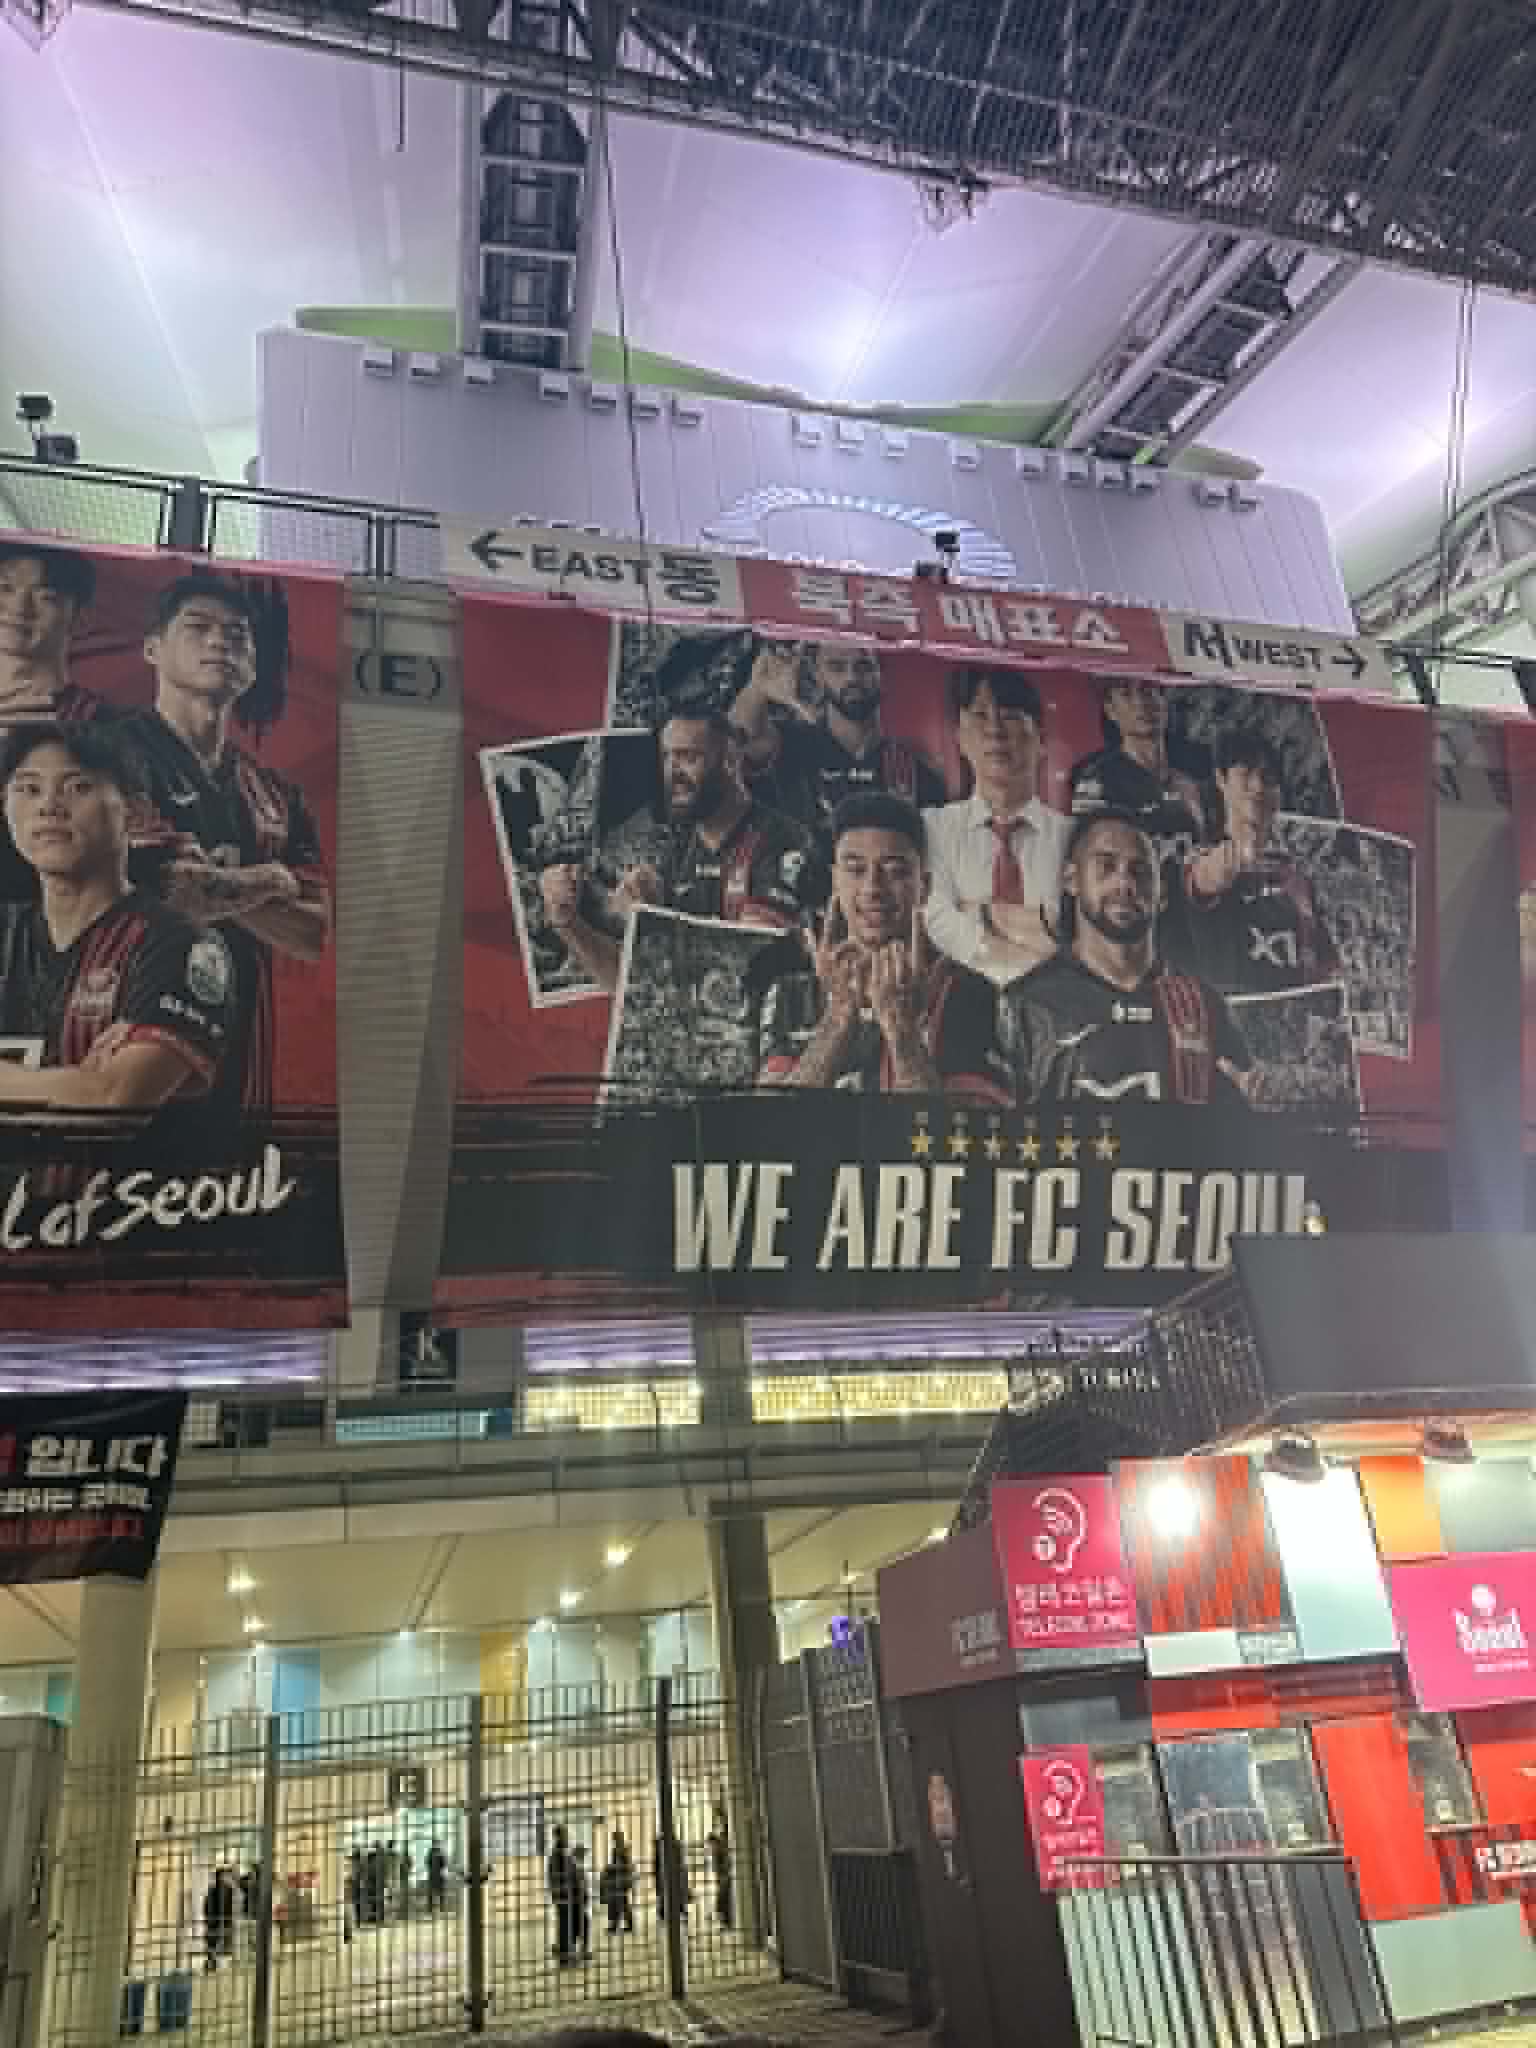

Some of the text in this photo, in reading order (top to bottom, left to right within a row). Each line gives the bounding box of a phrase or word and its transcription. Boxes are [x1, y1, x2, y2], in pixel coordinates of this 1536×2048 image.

[530, 545, 722, 603] EAST 동
[795, 574, 1129, 654] 북측 매표소
[1232, 636, 1321, 672] WEST
[672, 1162, 793, 1272] WE
[816, 1163, 966, 1271] ARE
[992, 1166, 1081, 1270] FC
